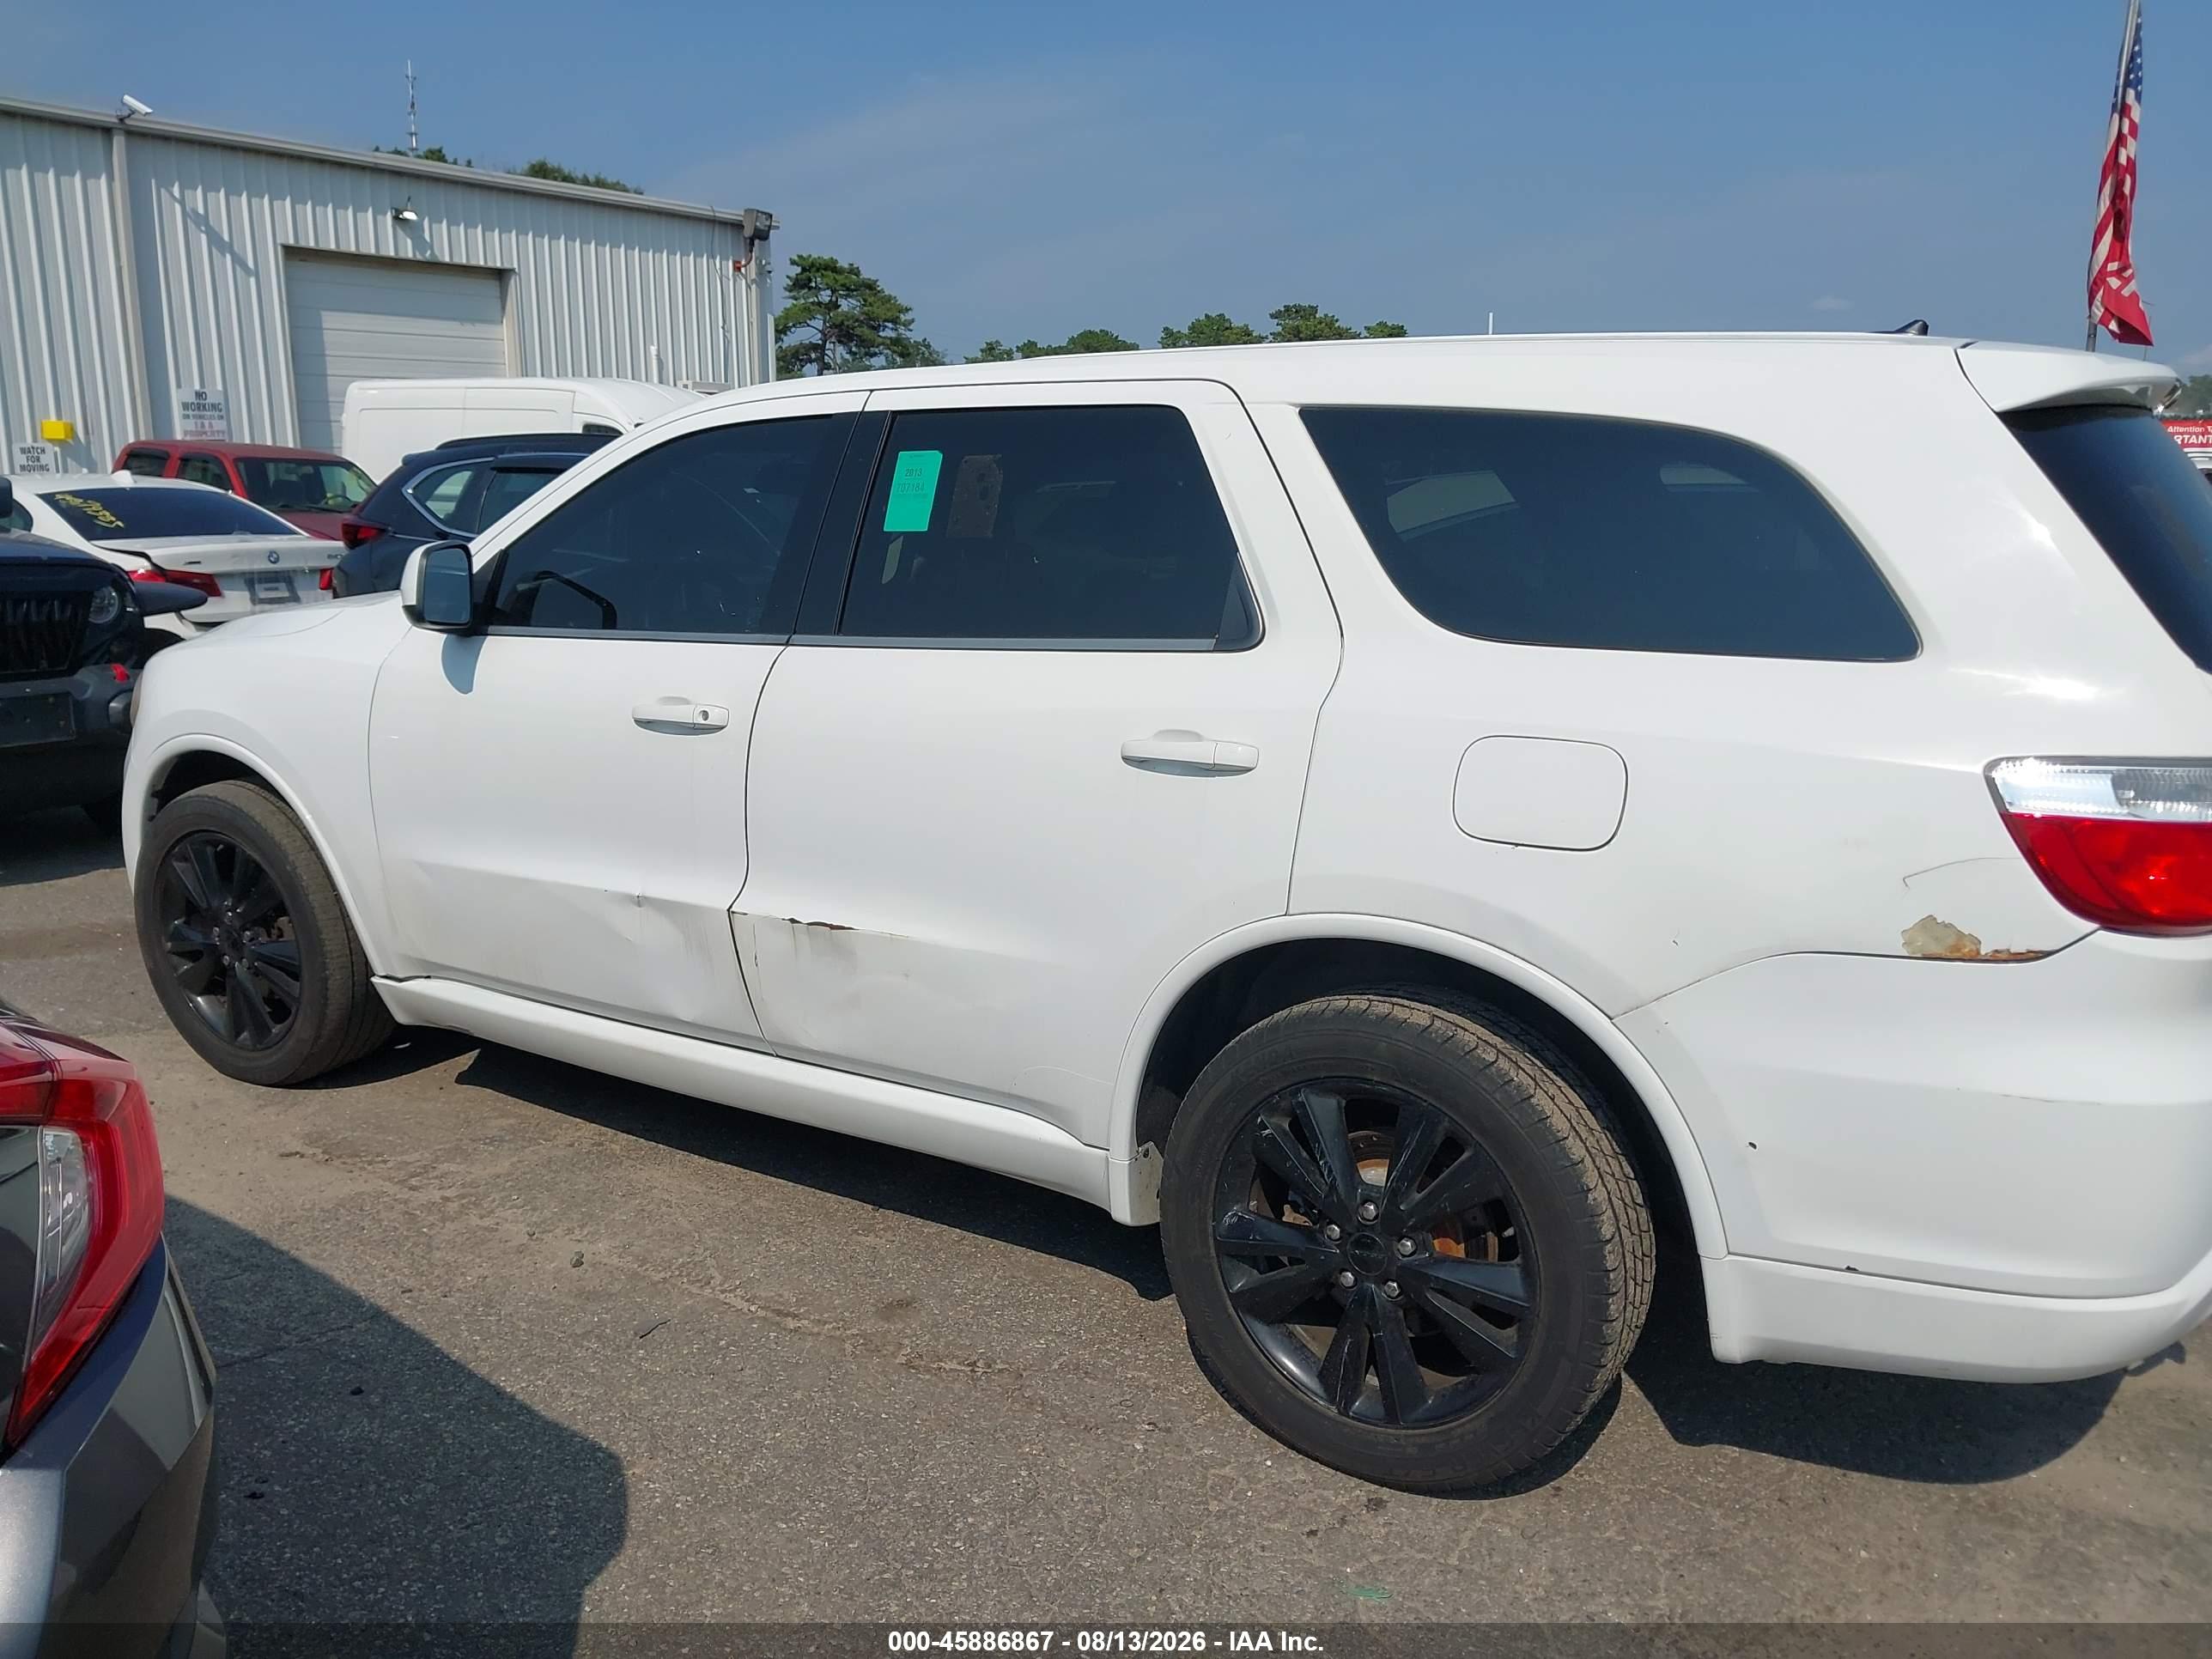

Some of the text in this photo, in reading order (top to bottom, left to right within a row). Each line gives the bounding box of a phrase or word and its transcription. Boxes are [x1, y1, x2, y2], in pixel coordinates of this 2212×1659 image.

[195, 391, 207, 401] NO
[181, 401, 222, 412] WORKING
[19, 445, 46, 455] WATCH
[26, 455, 40, 464] FOR
[19, 464, 50, 472] MOVING
